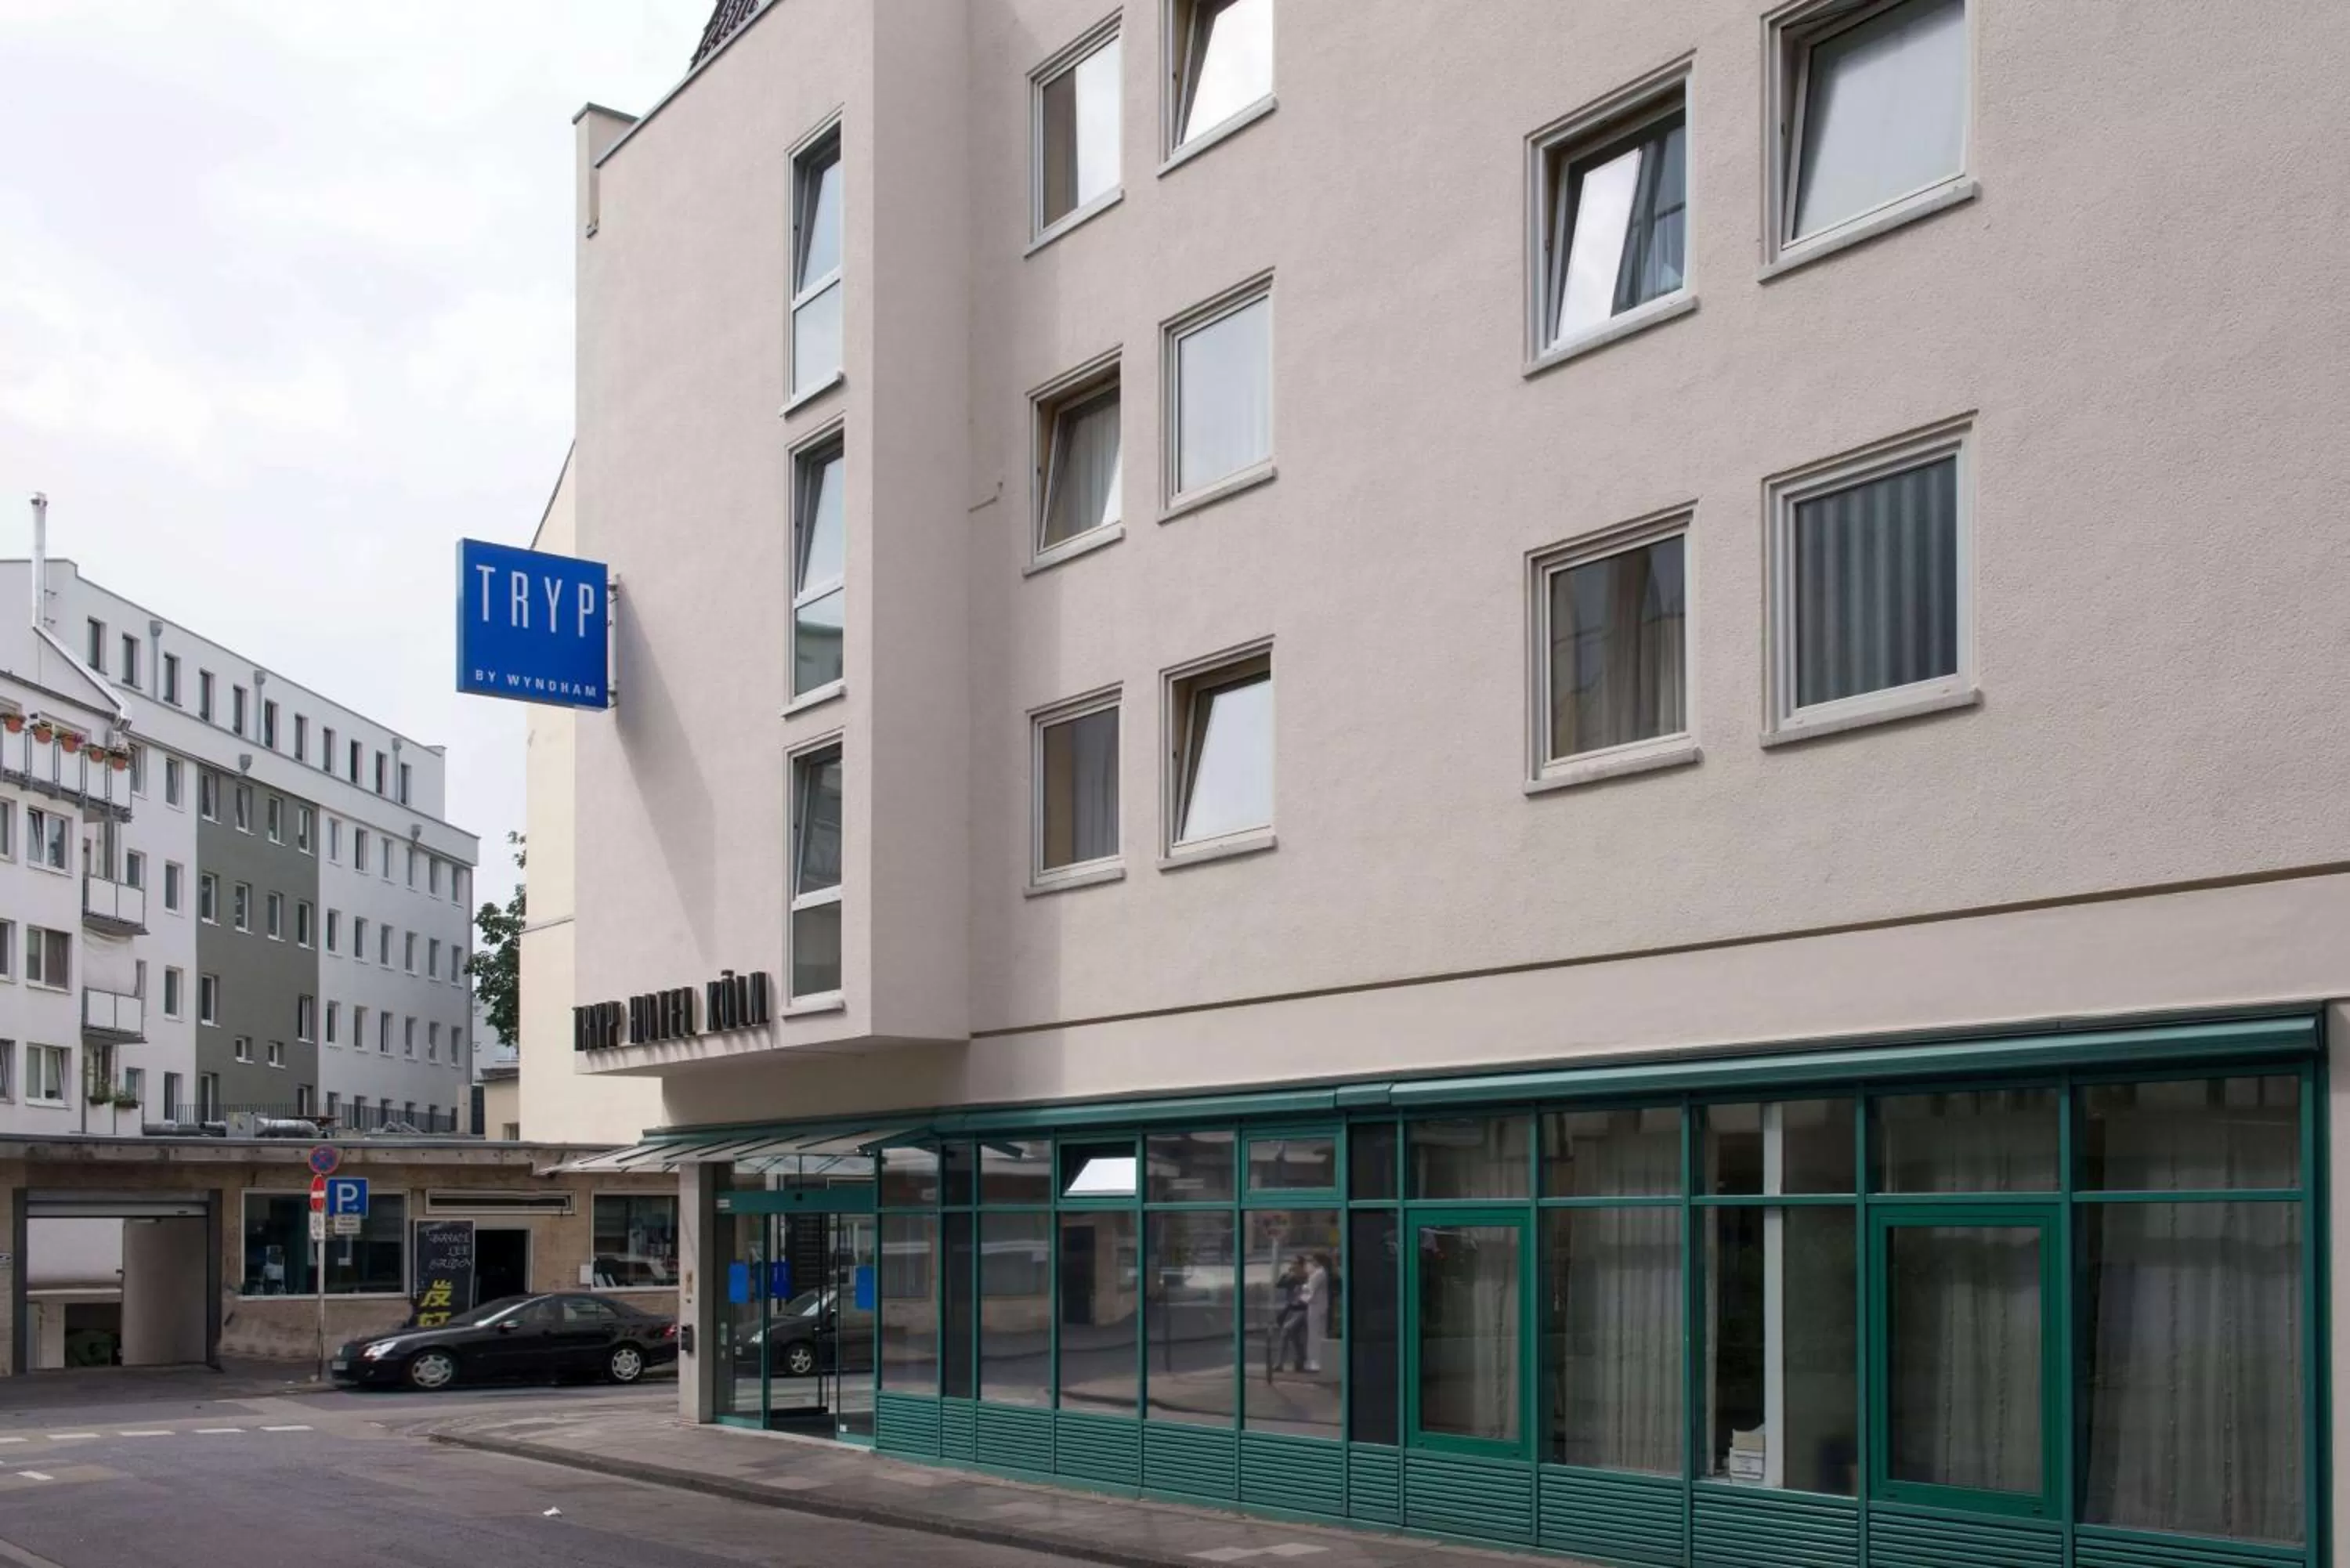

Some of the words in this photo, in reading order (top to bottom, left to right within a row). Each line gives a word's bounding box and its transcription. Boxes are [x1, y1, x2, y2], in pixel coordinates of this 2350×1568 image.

[475, 565, 595, 638] TRYP
[475, 670, 496, 683] BY
[507, 674, 597, 697] WYNDHAM
[572, 1001, 620, 1051] TRYP
[629, 986, 695, 1043] HOTEL
[707, 970, 770, 1031] KÖLN
[337, 1183, 358, 1212] P
